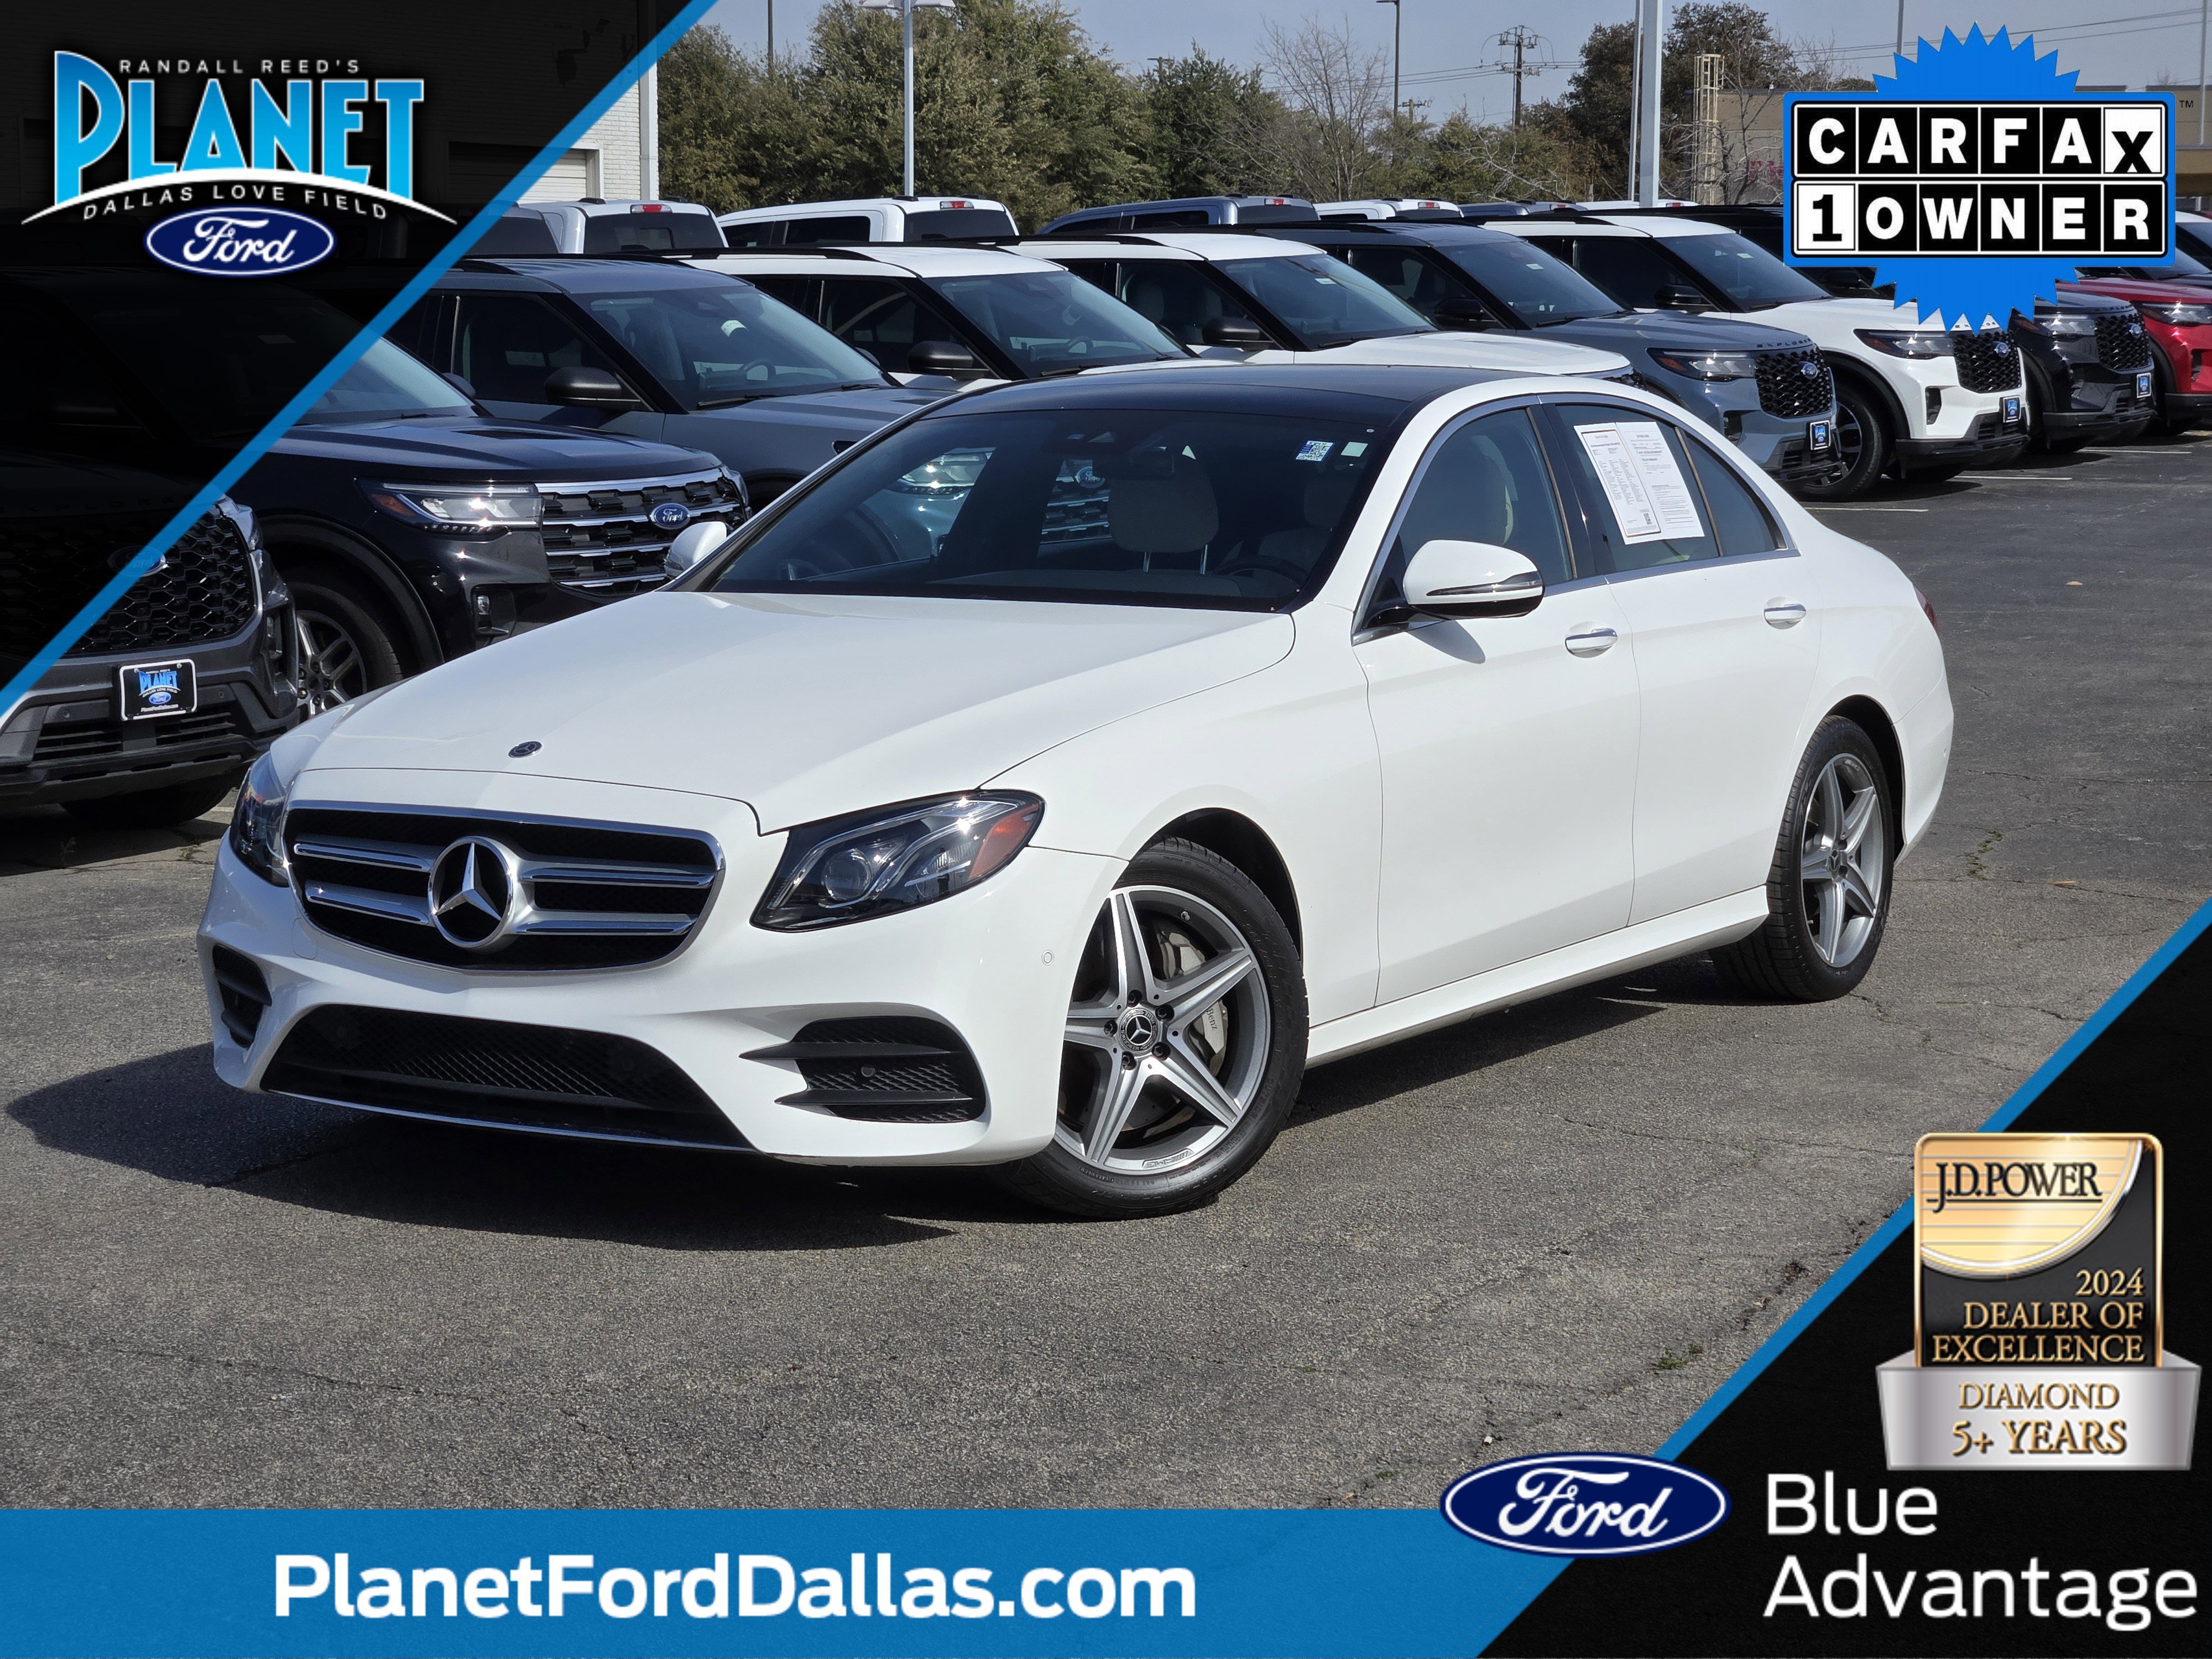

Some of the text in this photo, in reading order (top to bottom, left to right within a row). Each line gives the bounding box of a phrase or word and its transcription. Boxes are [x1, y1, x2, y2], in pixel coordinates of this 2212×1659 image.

[662, 508, 684, 522] Ford
[139, 671, 177, 693] PLANET
[1206, 1008, 1218, 1031] Benz
